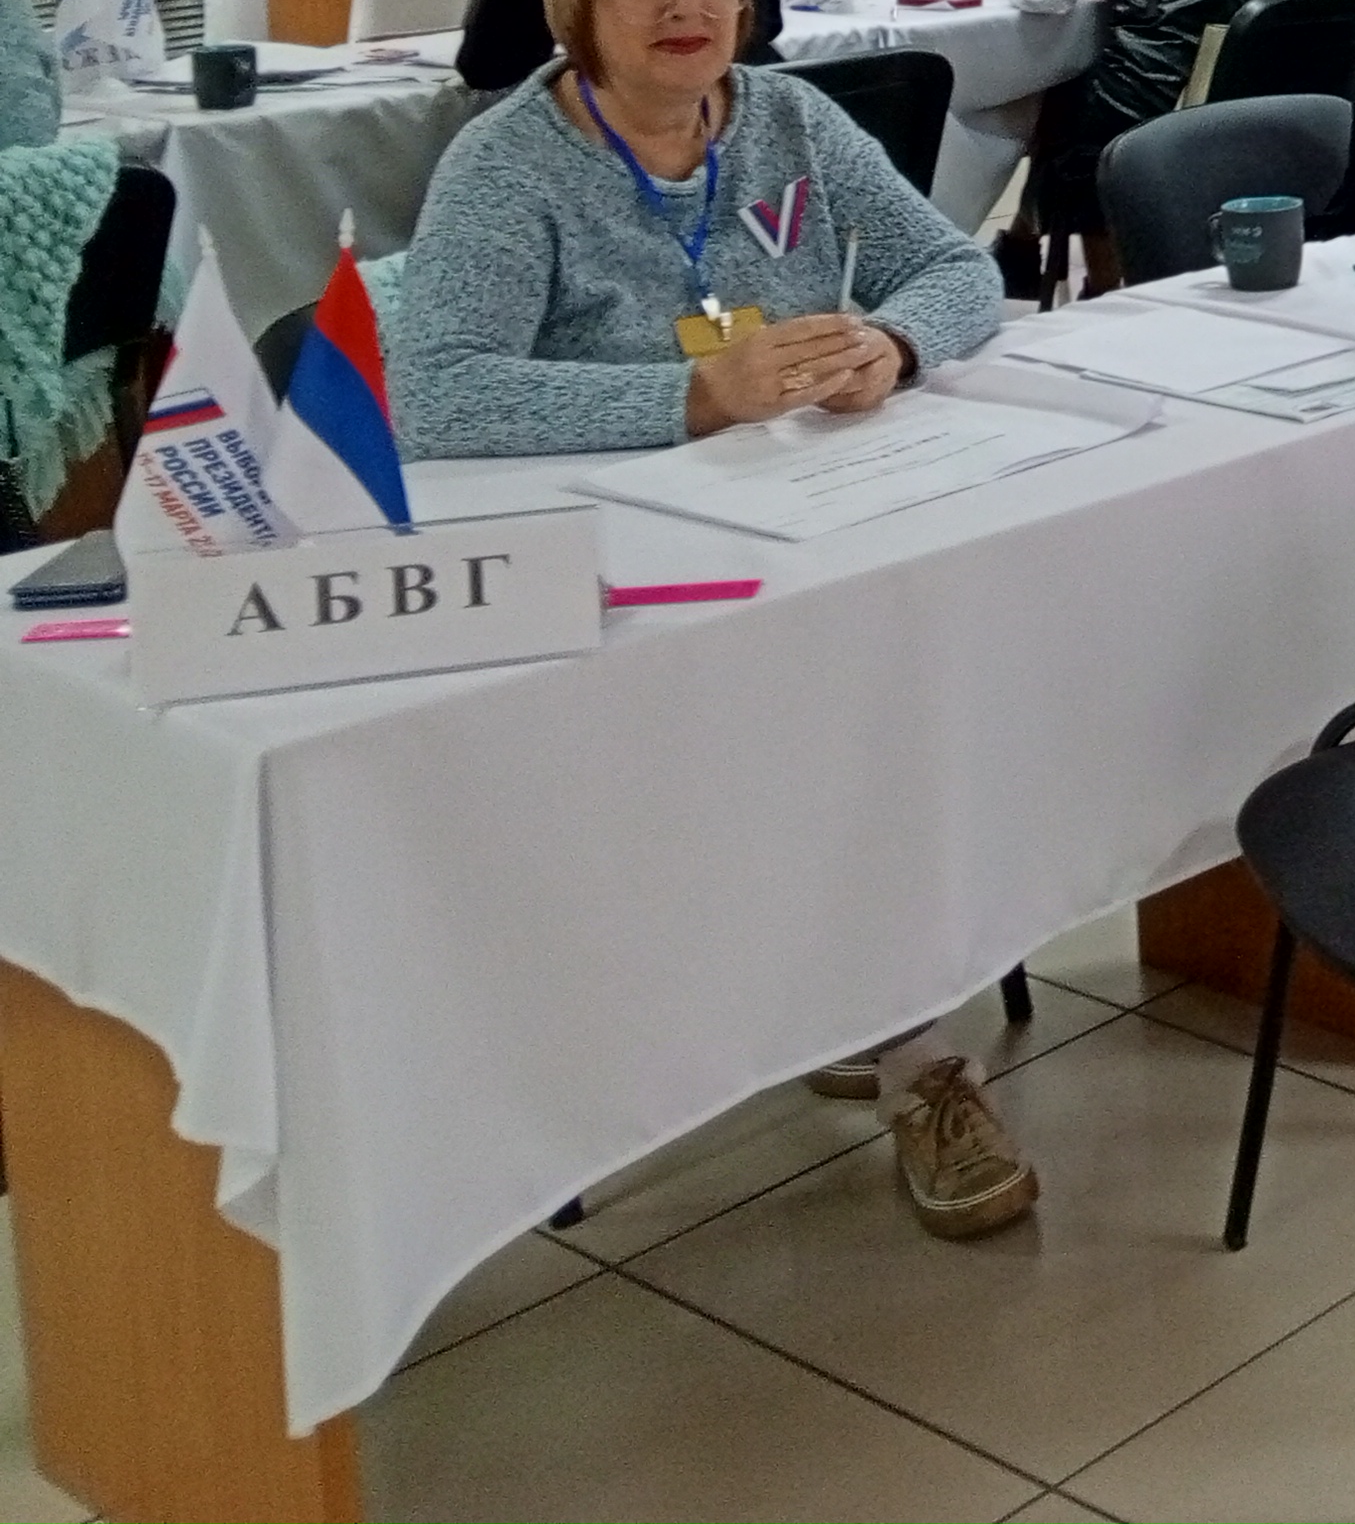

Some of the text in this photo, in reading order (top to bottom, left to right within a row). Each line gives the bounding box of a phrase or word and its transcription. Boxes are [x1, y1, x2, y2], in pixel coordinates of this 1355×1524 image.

[155, 444, 226, 519] РОССИИ
[156, 488, 200, 538] МАРТА
[226, 550, 513, 638] АБВГ
